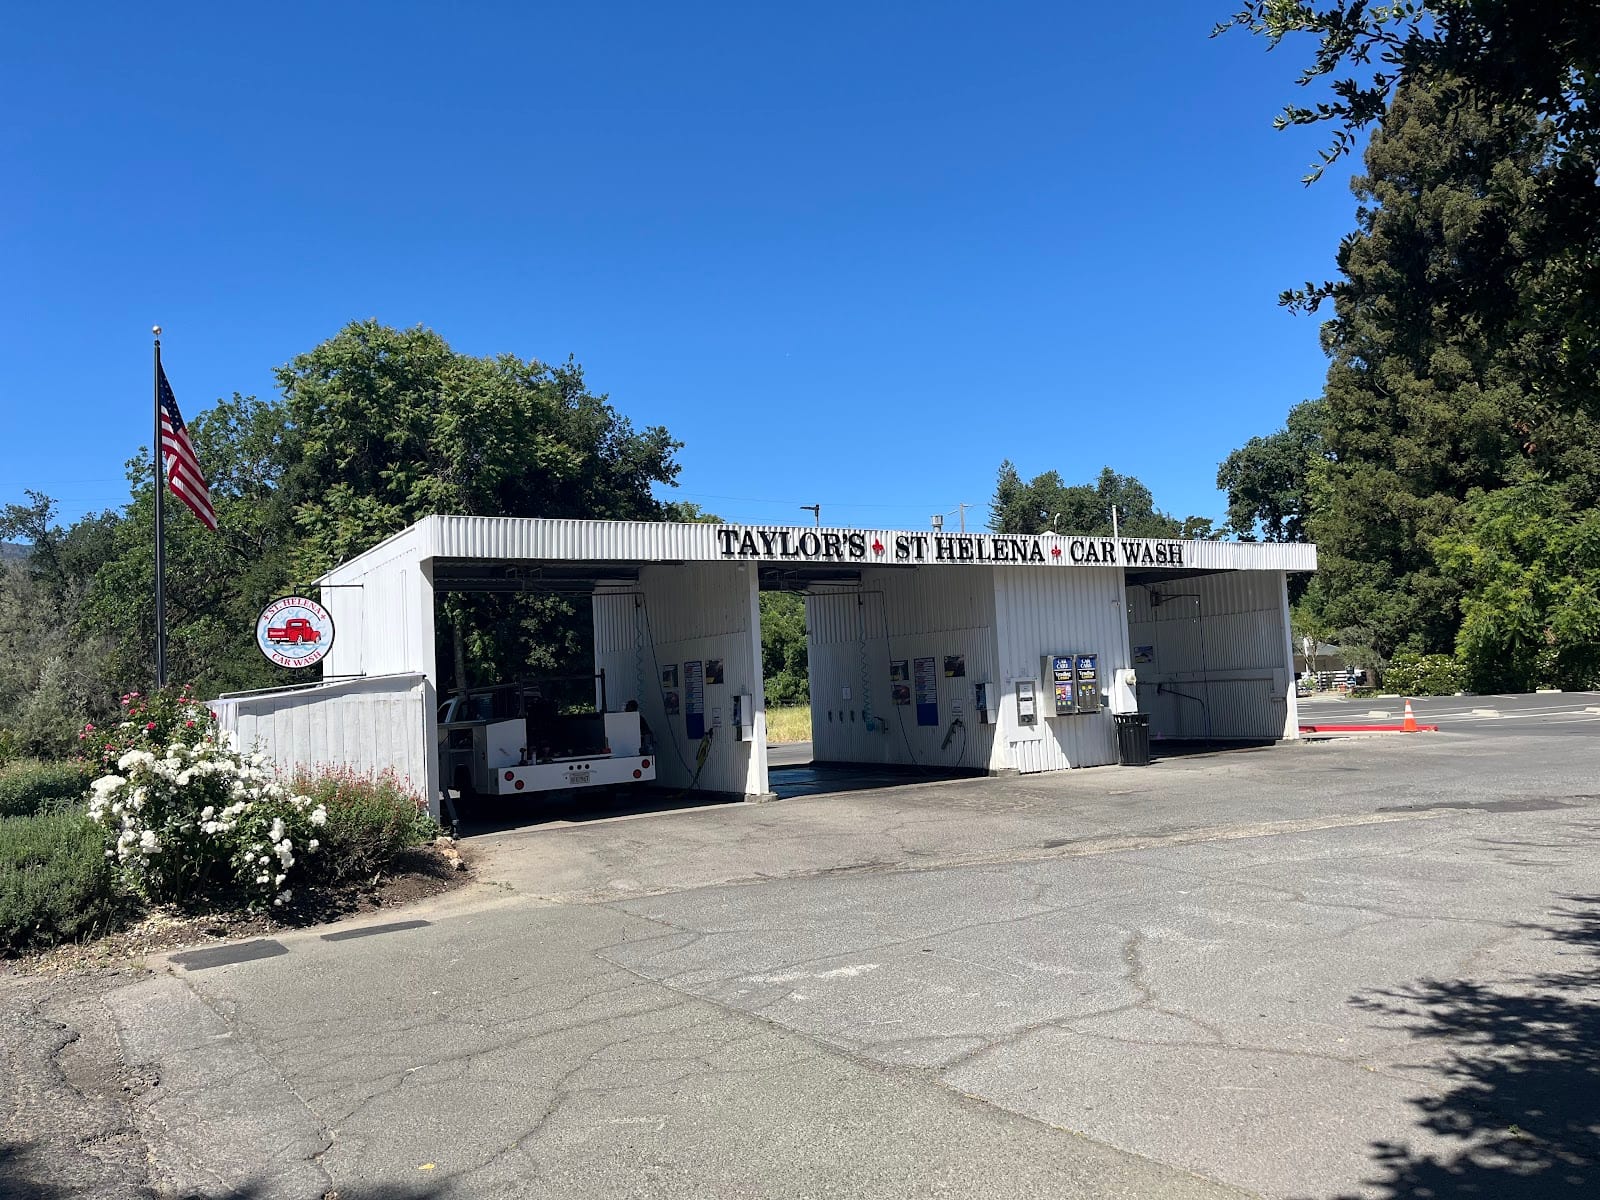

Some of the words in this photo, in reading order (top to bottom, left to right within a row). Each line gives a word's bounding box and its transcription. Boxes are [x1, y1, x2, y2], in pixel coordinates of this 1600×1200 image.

[718, 529, 865, 557] TAYLOR'S
[895, 535, 928, 559] ST
[934, 536, 1045, 562] HELENA
[1070, 540, 1117, 563] CAR
[1121, 541, 1184, 564] WASH
[283, 599, 321, 614] HELENA
[272, 653, 290, 666] CAR
[292, 651, 321, 667] WASH
